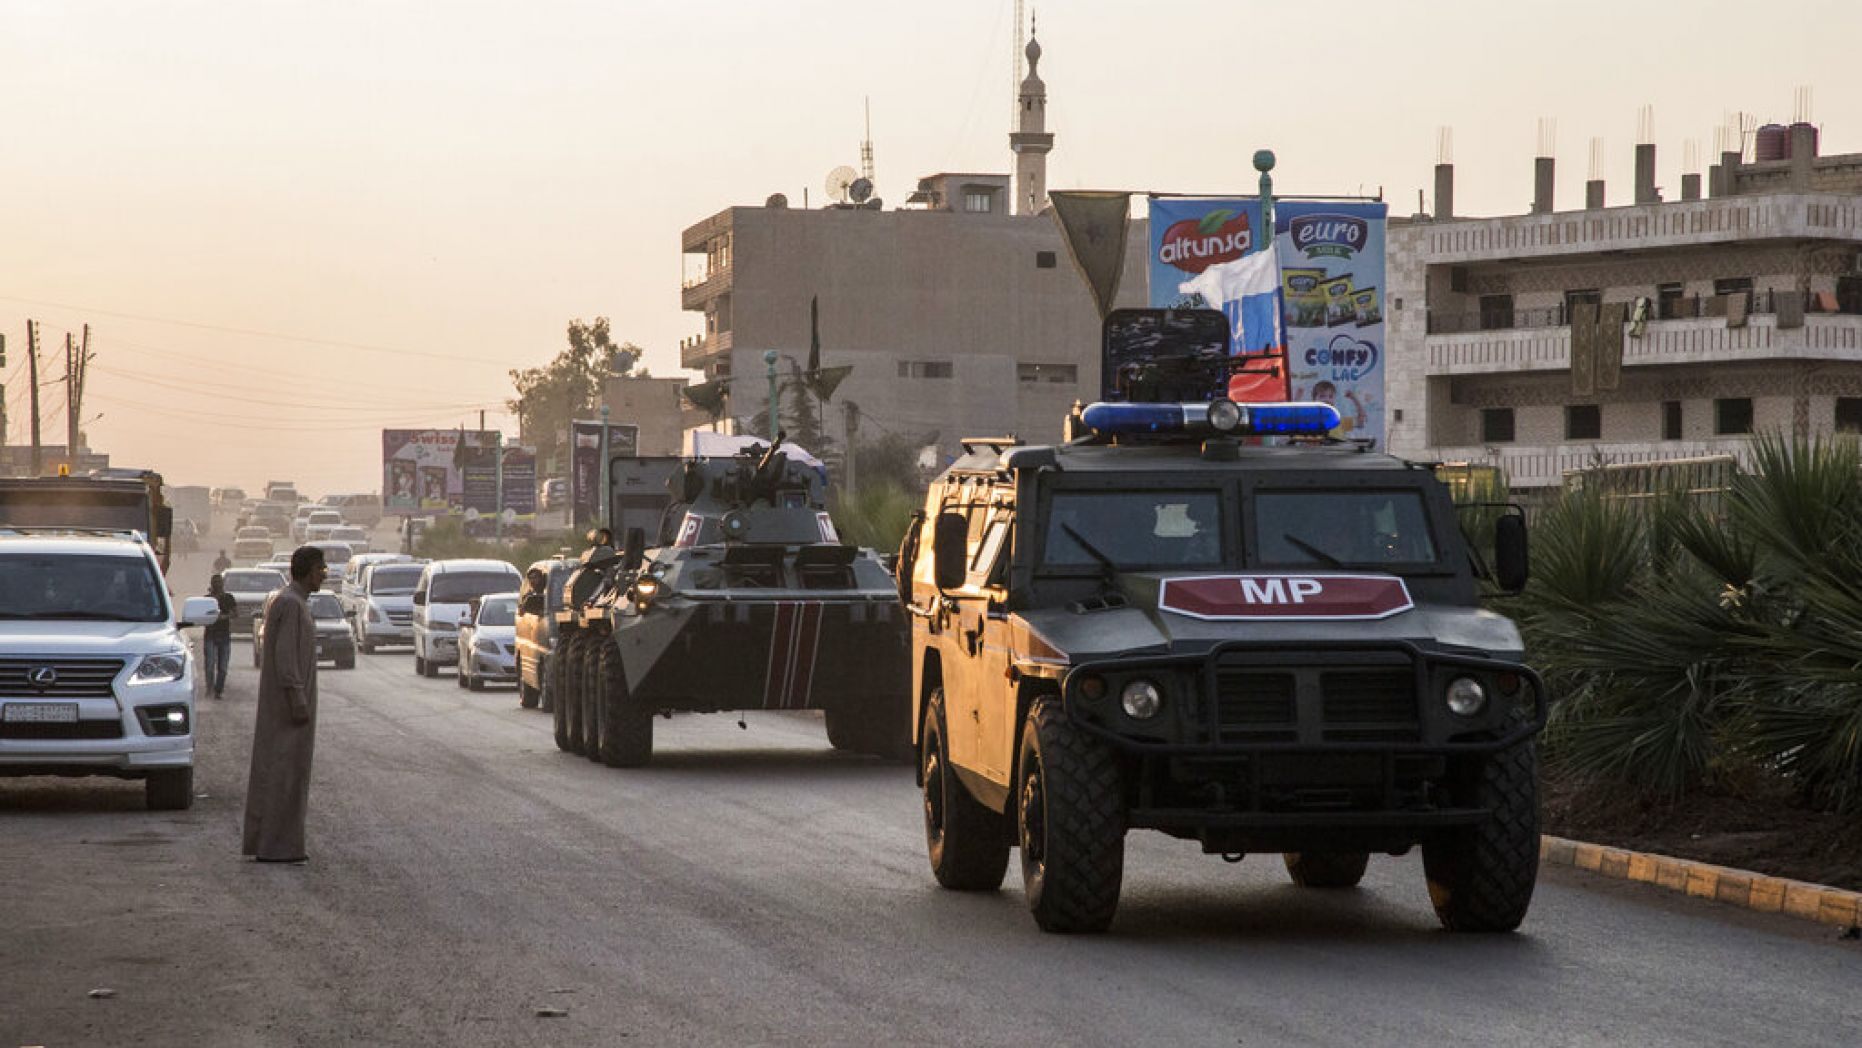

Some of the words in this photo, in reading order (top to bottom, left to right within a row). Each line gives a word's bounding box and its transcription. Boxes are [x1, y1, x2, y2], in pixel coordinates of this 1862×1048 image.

[1299, 221, 1360, 243] euro
[1160, 229, 1251, 263] altunsa
[1240, 579, 1322, 604] MP
